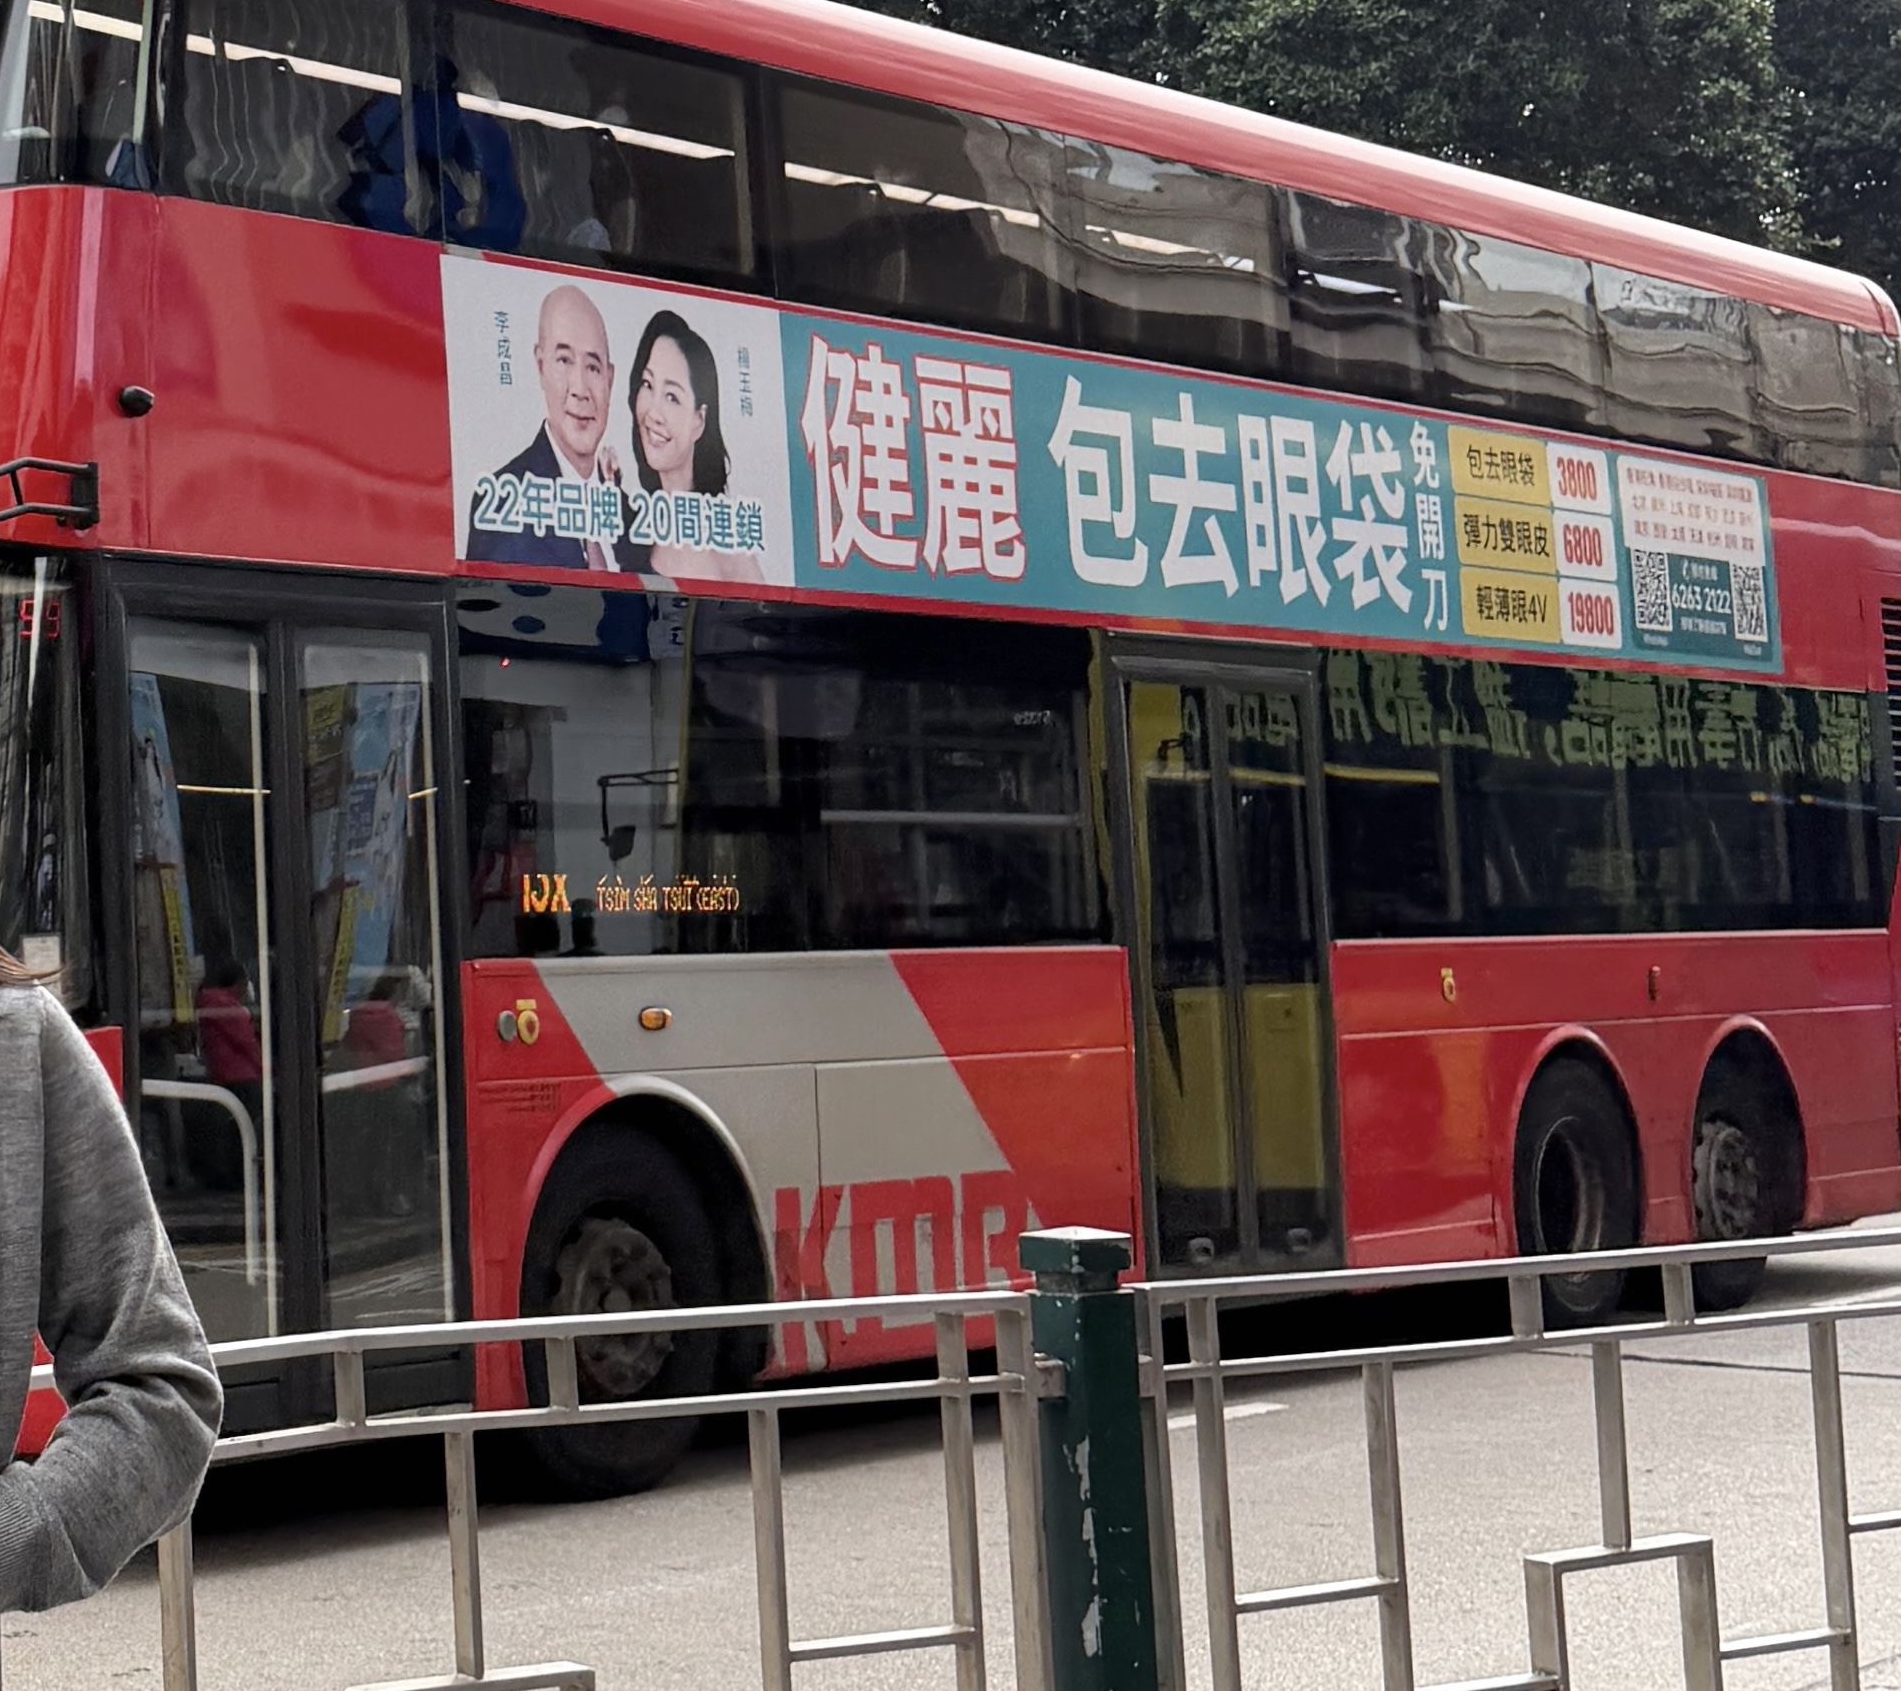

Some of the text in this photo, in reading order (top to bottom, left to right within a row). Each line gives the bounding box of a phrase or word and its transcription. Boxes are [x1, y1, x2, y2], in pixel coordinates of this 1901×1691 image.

[801, 334, 1413, 614] 健麗 包去眼袋
[1466, 444, 1536, 487] 包去眼袋
[1556, 456, 1598, 501] 3800
[476, 476, 766, 551] 22年品牌 20間連鎖
[1409, 421, 1450, 632] 免開刀
[1463, 513, 1550, 557] 彈力雙眼皮
[1562, 523, 1603, 567] 6800
[1568, 591, 1615, 636] 19800
[1671, 582, 1732, 615] 6263 2122
[596, 886, 631, 912] TSIM
[633, 886, 658, 912] SHA
[662, 886, 693, 912] TSUI
